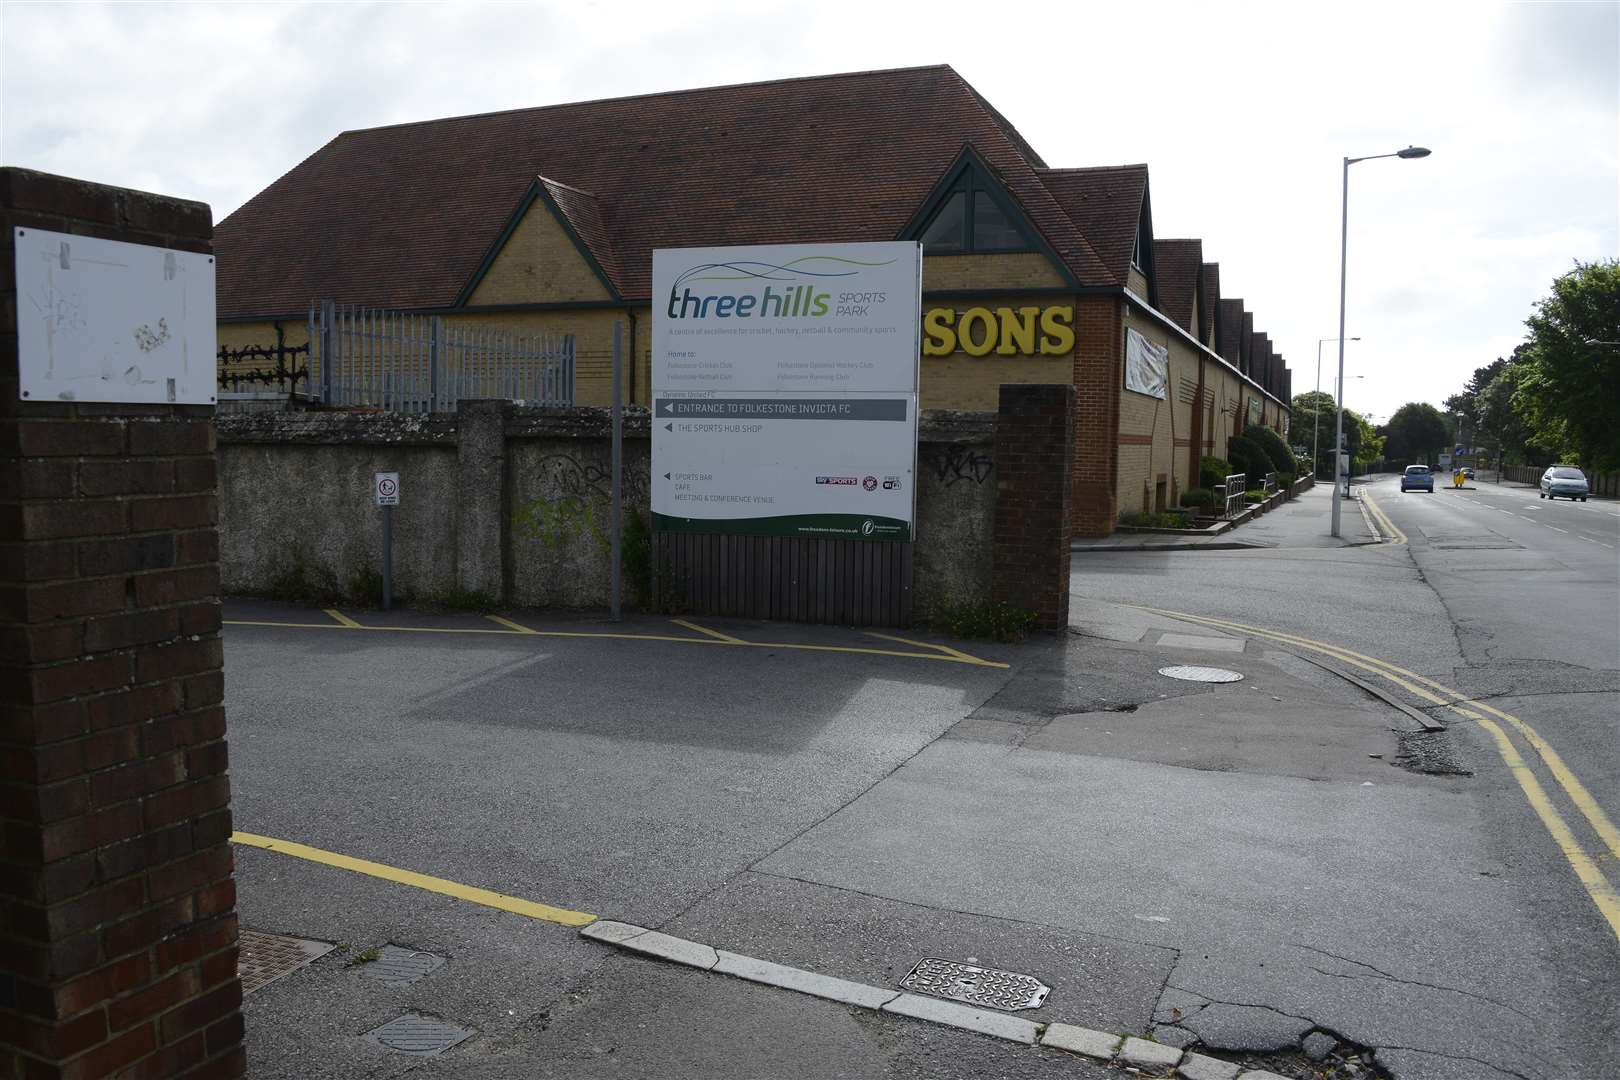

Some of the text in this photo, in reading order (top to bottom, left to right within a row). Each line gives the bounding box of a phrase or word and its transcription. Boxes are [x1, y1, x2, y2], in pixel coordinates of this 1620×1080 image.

[667, 285, 831, 319] three hills
[838, 292, 887, 304] SPORTS
[836, 305, 869, 317] PARK
[678, 403, 851, 414] ENTRANCE TO FOLKESTONE INVICTA FC
[678, 423, 763, 433] THE SPORTS HUB SHOP
[675, 473, 713, 481] SPORTS BAR
[675, 493, 702, 502] MEETING
[710, 495, 752, 503] CONFERENCE
[753, 495, 776, 504] VENUE
